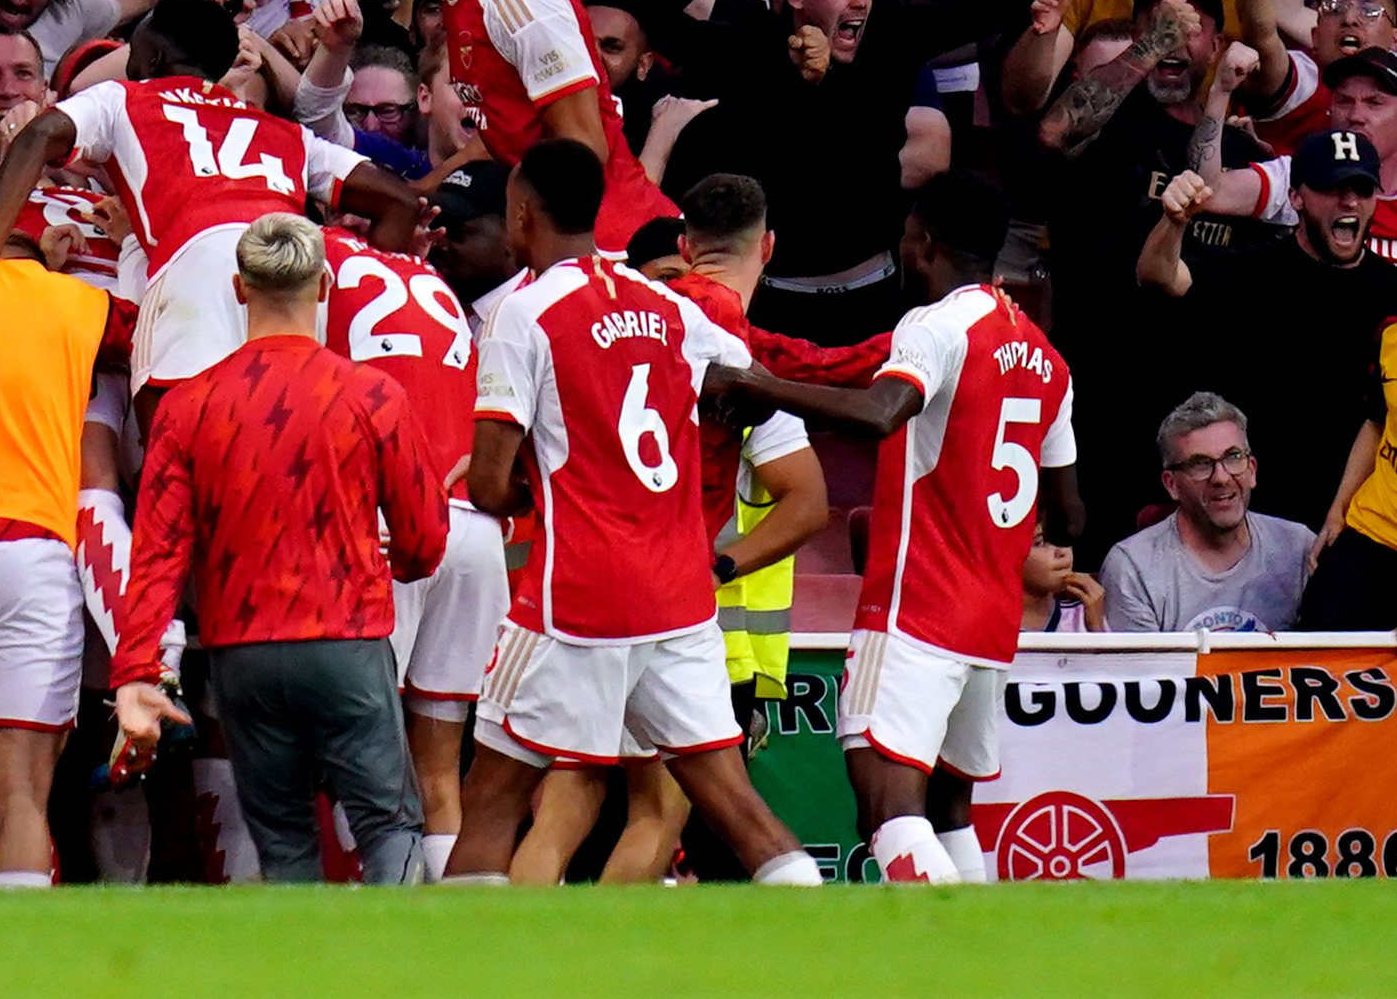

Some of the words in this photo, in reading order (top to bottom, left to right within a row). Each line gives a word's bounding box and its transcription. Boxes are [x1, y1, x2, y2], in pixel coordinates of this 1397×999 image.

[162, 104, 296, 196] 14
[1330, 130, 1361, 162] H
[1191, 220, 1233, 248] ETTER
[336, 257, 472, 371] 29
[591, 310, 668, 350] GABRIEL
[993, 341, 1053, 384] THMAS
[617, 363, 678, 493] 6
[987, 397, 1042, 528] 5
[1004, 666, 1396, 727] GOONERS
[1248, 828, 1397, 880] 188
